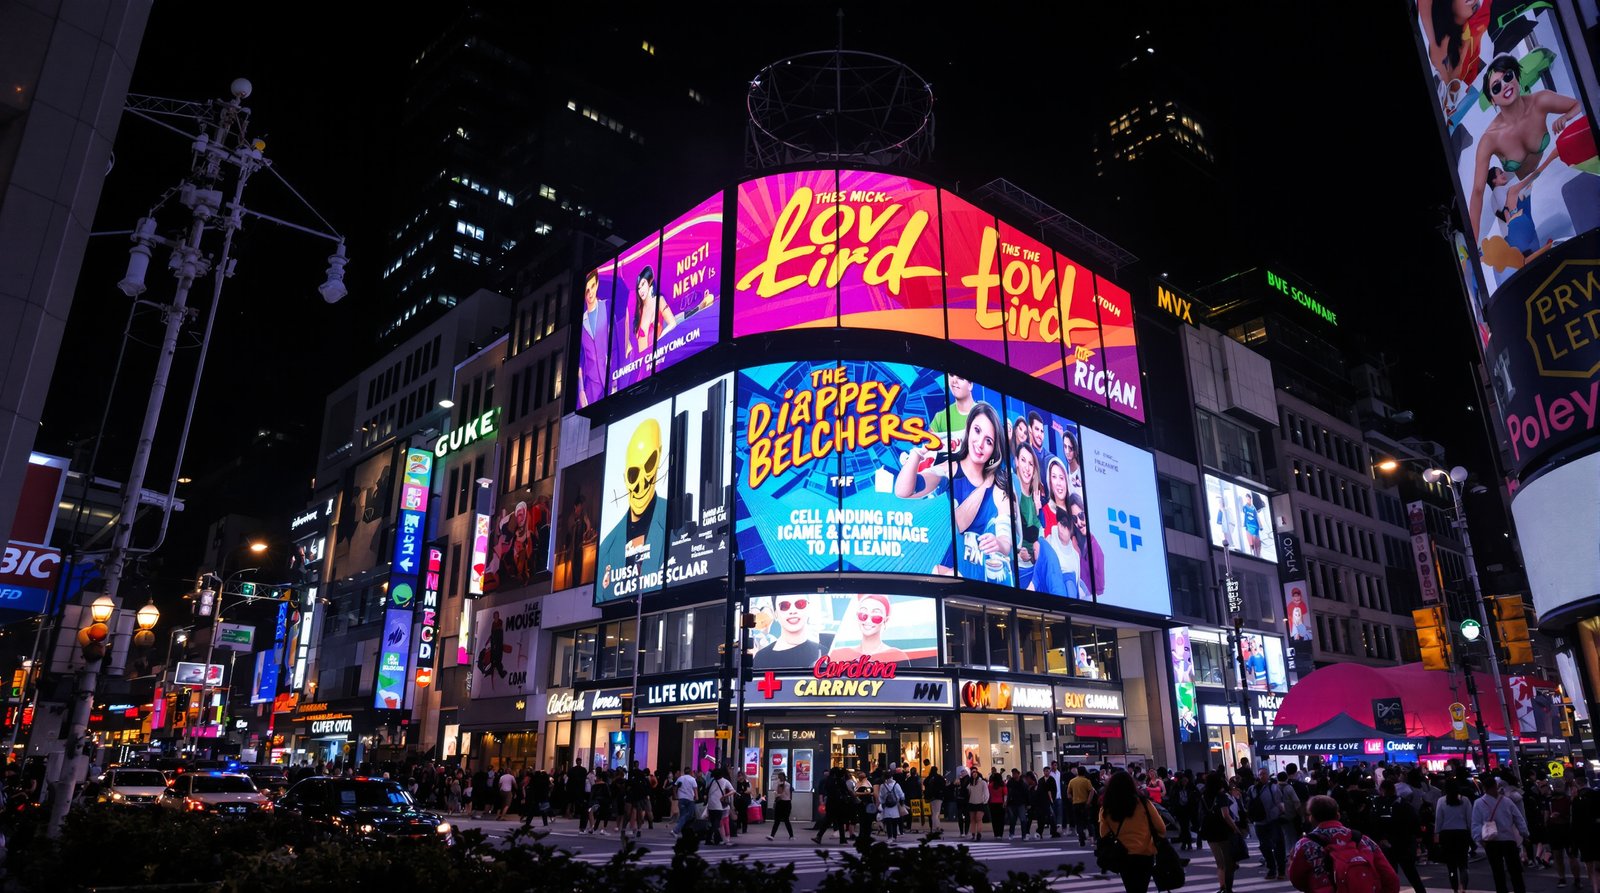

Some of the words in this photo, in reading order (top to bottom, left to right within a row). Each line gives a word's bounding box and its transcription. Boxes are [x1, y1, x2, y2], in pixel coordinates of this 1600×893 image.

[1023, 249, 1041, 262] THE
[1157, 286, 1194, 325] MVX
[811, 366, 848, 388] THE
[434, 409, 494, 458] GUKE
[748, 413, 943, 489] BELCHERS
[790, 509, 823, 525] CELL
[887, 510, 914, 527] FOR
[826, 525, 839, 541] &
[806, 540, 825, 556] TO
[829, 540, 850, 556] AN
[505, 611, 541, 632] MOUSE
[648, 683, 677, 705] LLFE
[793, 679, 884, 697] CARRNCY
